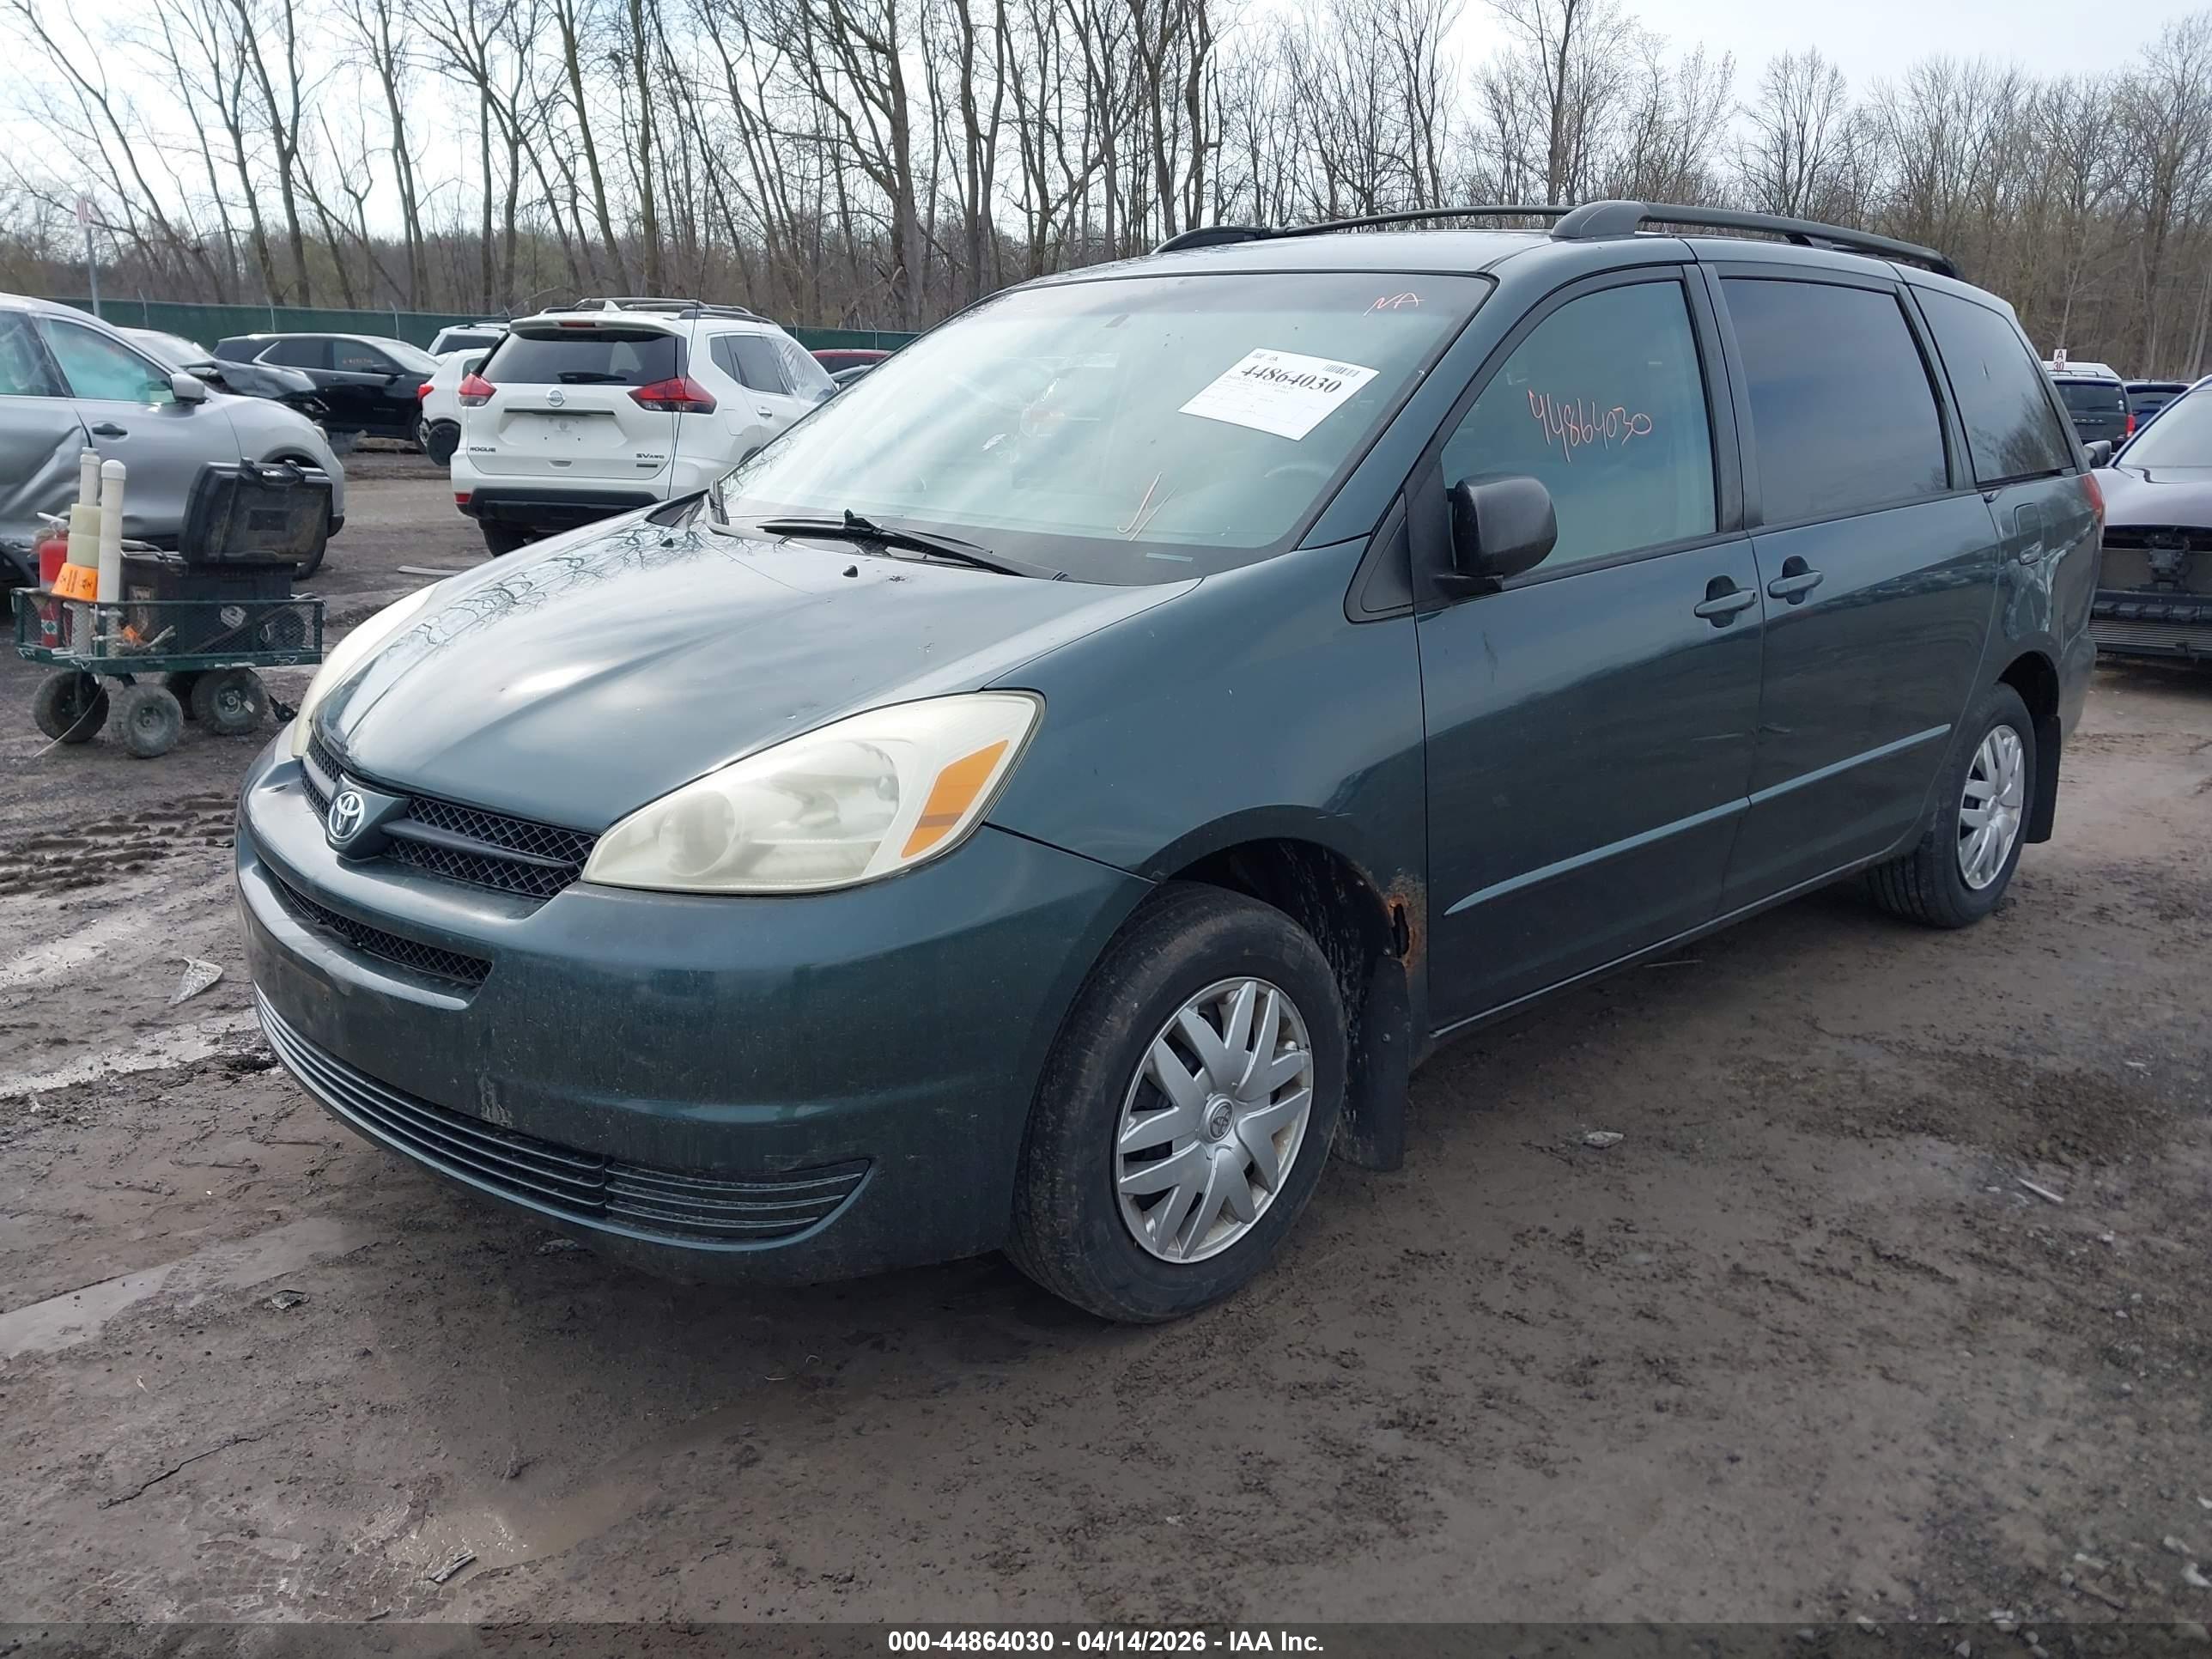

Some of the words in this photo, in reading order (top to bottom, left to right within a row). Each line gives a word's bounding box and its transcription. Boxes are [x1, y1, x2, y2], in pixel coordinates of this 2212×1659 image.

[2056, 349, 2063, 360] A
[2053, 361, 2064, 371] 30
[1241, 364, 1342, 394] 44864030
[1528, 389, 1652, 463] 44864030
